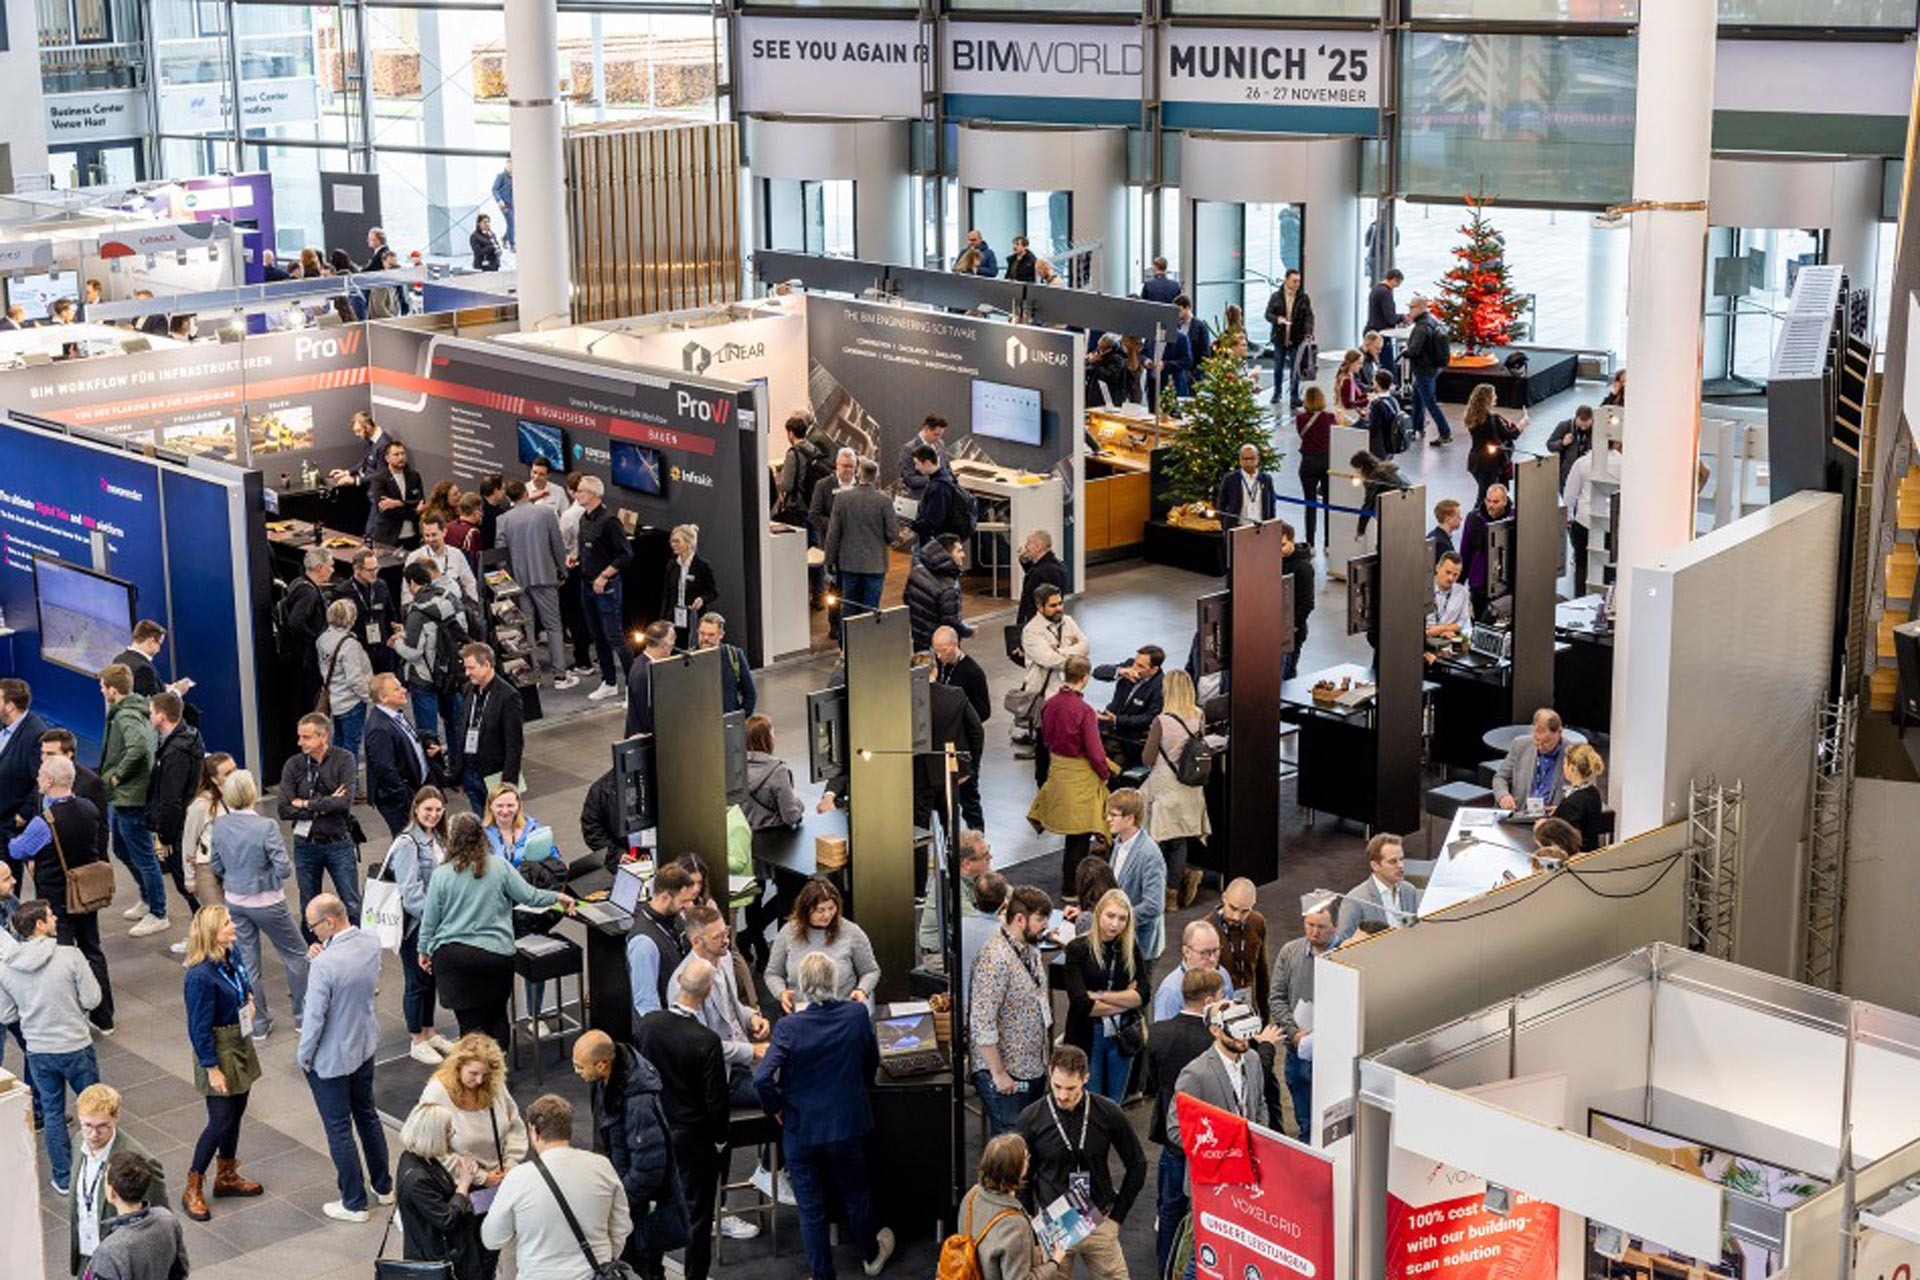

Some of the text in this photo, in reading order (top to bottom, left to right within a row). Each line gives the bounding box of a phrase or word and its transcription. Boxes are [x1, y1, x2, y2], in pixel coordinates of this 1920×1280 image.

[752, 39, 791, 59] SEE
[797, 40, 837, 61] YOU
[842, 42, 907, 63] AGAIN
[952, 39, 1144, 76] BIMWORLD
[1169, 44, 1306, 80] MUNICH
[1246, 86, 1260, 99] 26
[1273, 87, 1287, 99] 27
[1291, 88, 1366, 102] NOVEMBER
[50, 103, 124, 117] Business Center
[52, 117, 106, 129] Venue Host
[843, 309, 859, 322] THE
[861, 311, 876, 324] BIM
[932, 323, 977, 341] SOFTWARE
[718, 343, 765, 363] LINEAR
[1031, 350, 1069, 367] LINEAR
[30, 385, 53, 399] BIM
[58, 374, 127, 394] WORKFLOW
[131, 368, 155, 385] FÜR
[682, 469, 714, 487] Infrakit
[1231, 1195, 1301, 1239] VOXELGRID
[1409, 1210, 1445, 1230] 100%
[1447, 1202, 1478, 1220] cost
[1206, 1216, 1246, 1242] UNSERE
[1247, 1232, 1308, 1272] LEISTUNGEN
[1407, 1217, 1532, 1253] with our building-
[1406, 1245, 1501, 1276] scan solution
